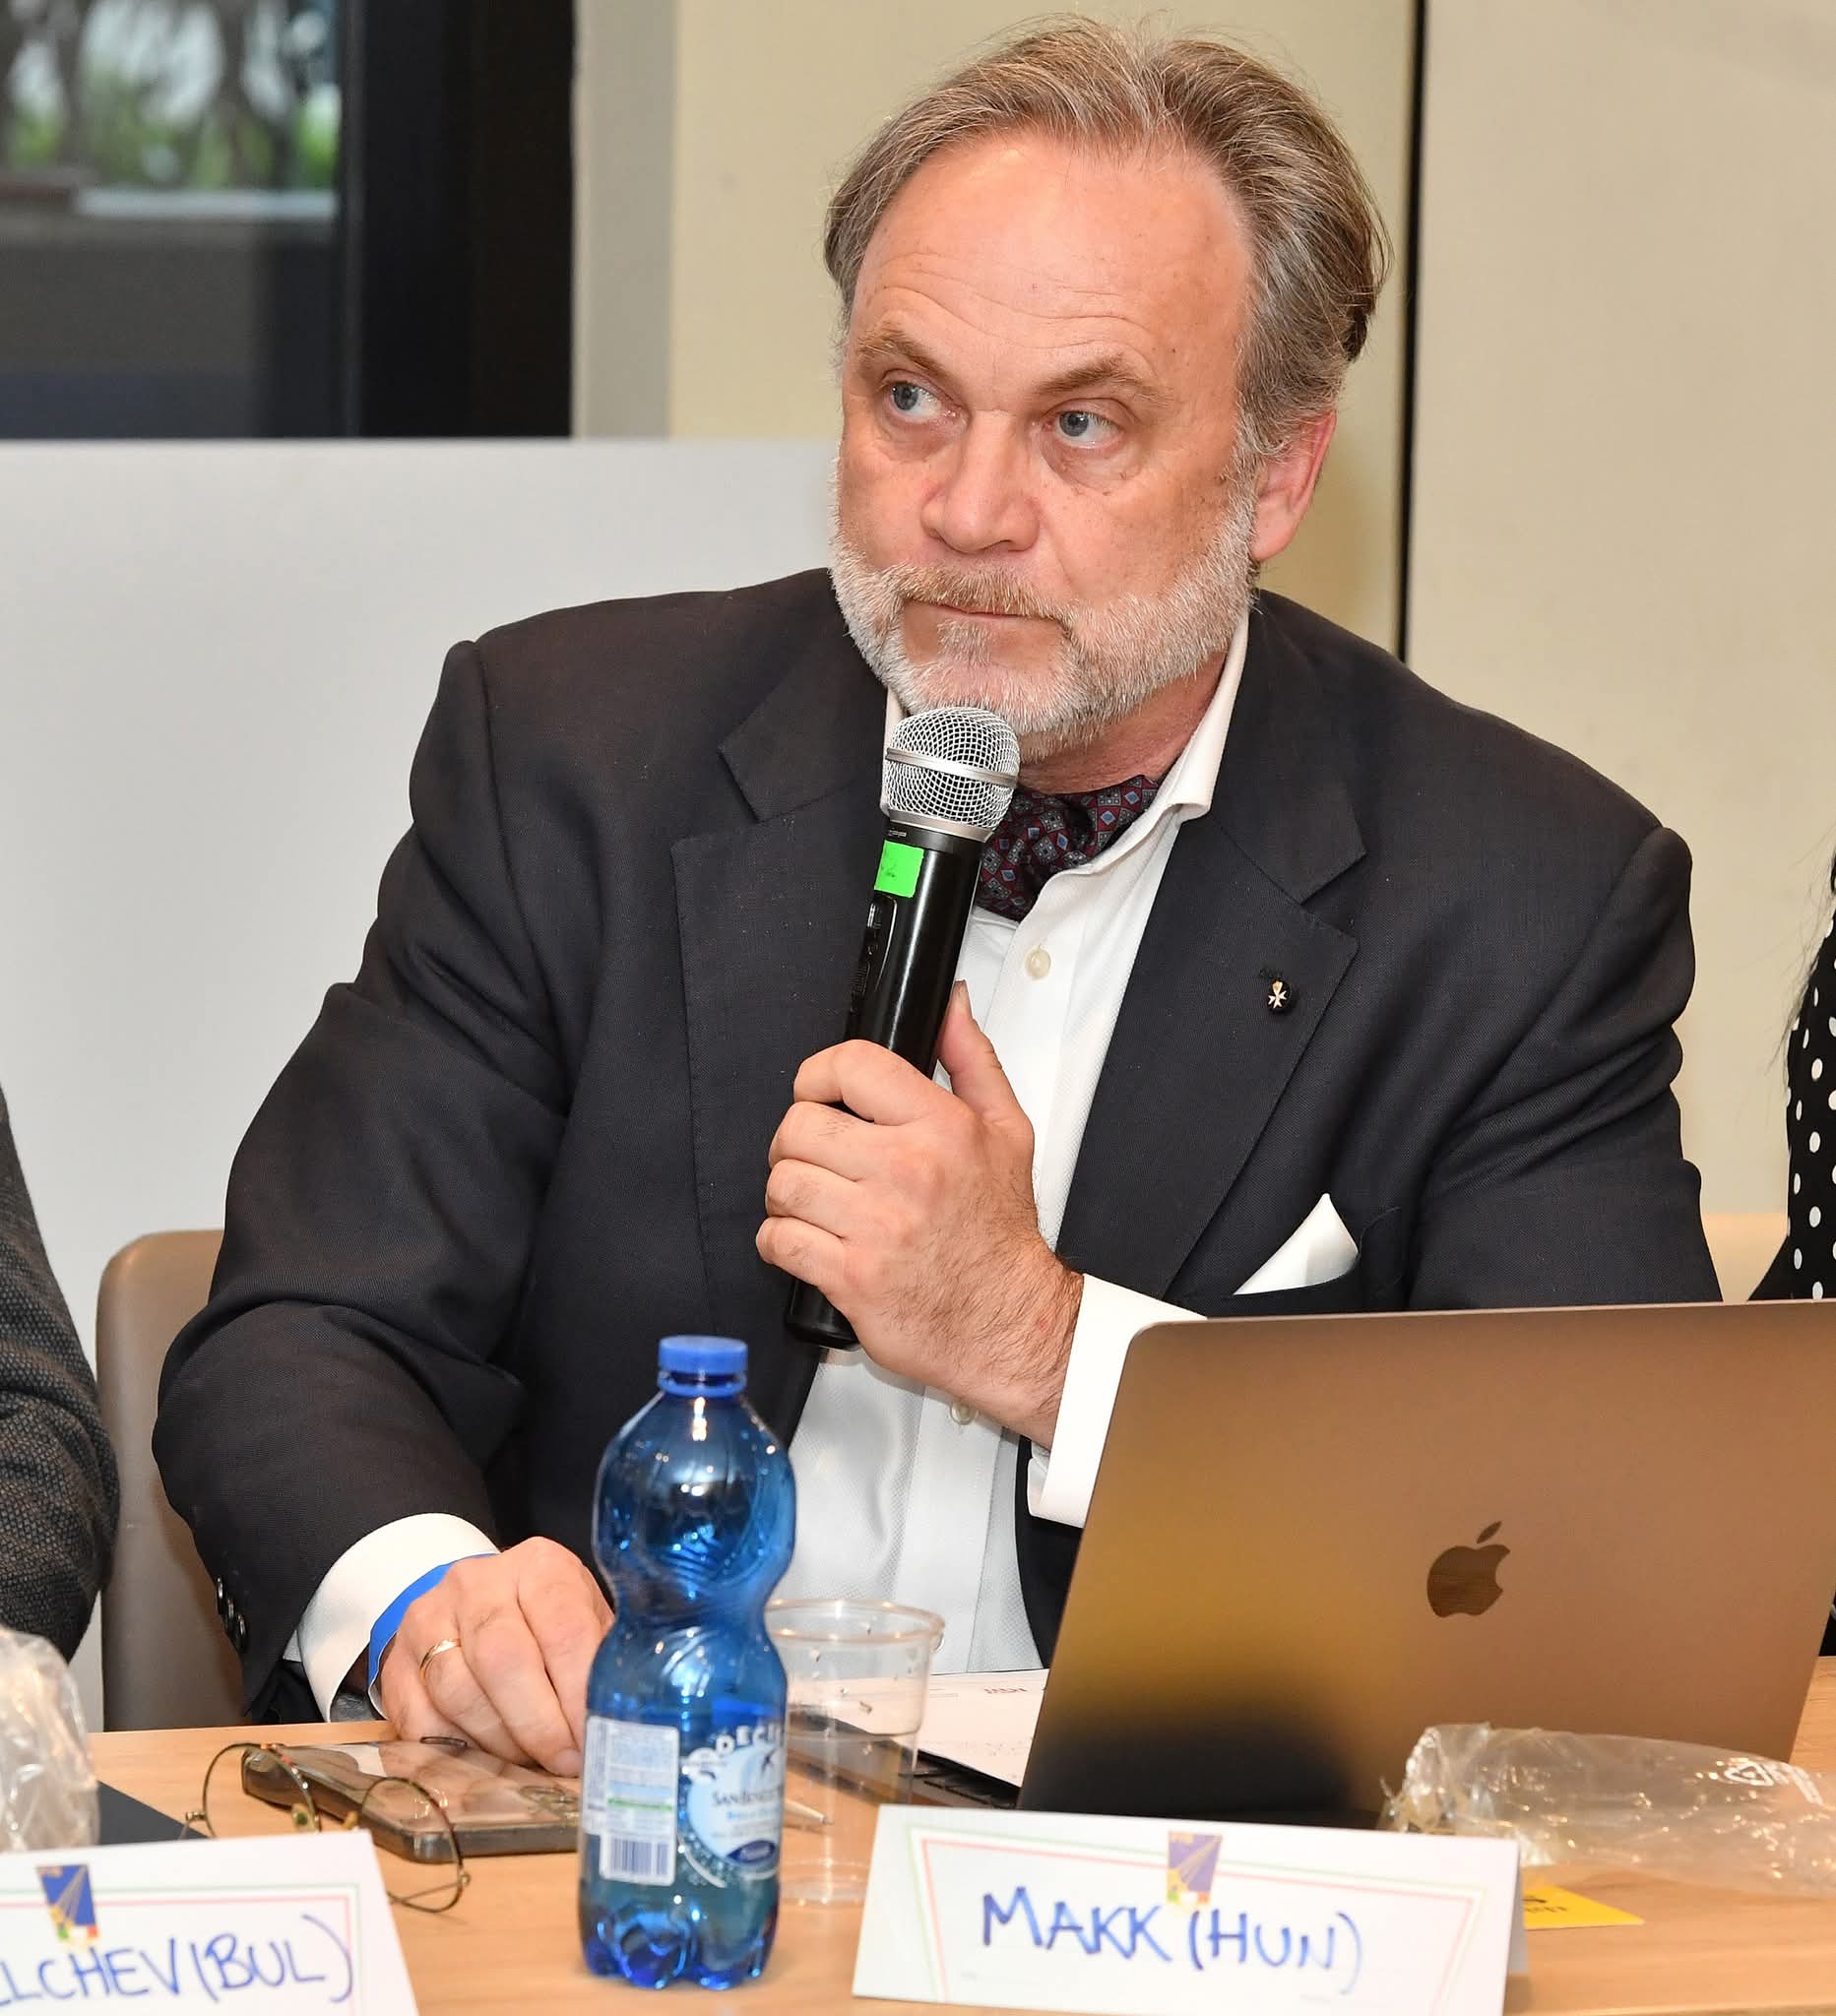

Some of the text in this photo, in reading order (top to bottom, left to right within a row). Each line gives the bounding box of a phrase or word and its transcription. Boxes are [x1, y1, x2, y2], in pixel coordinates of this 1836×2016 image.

[0, 1937, 180, 2006] LCHEV
[982, 1885, 1361, 1995] MAKK (HUN)
